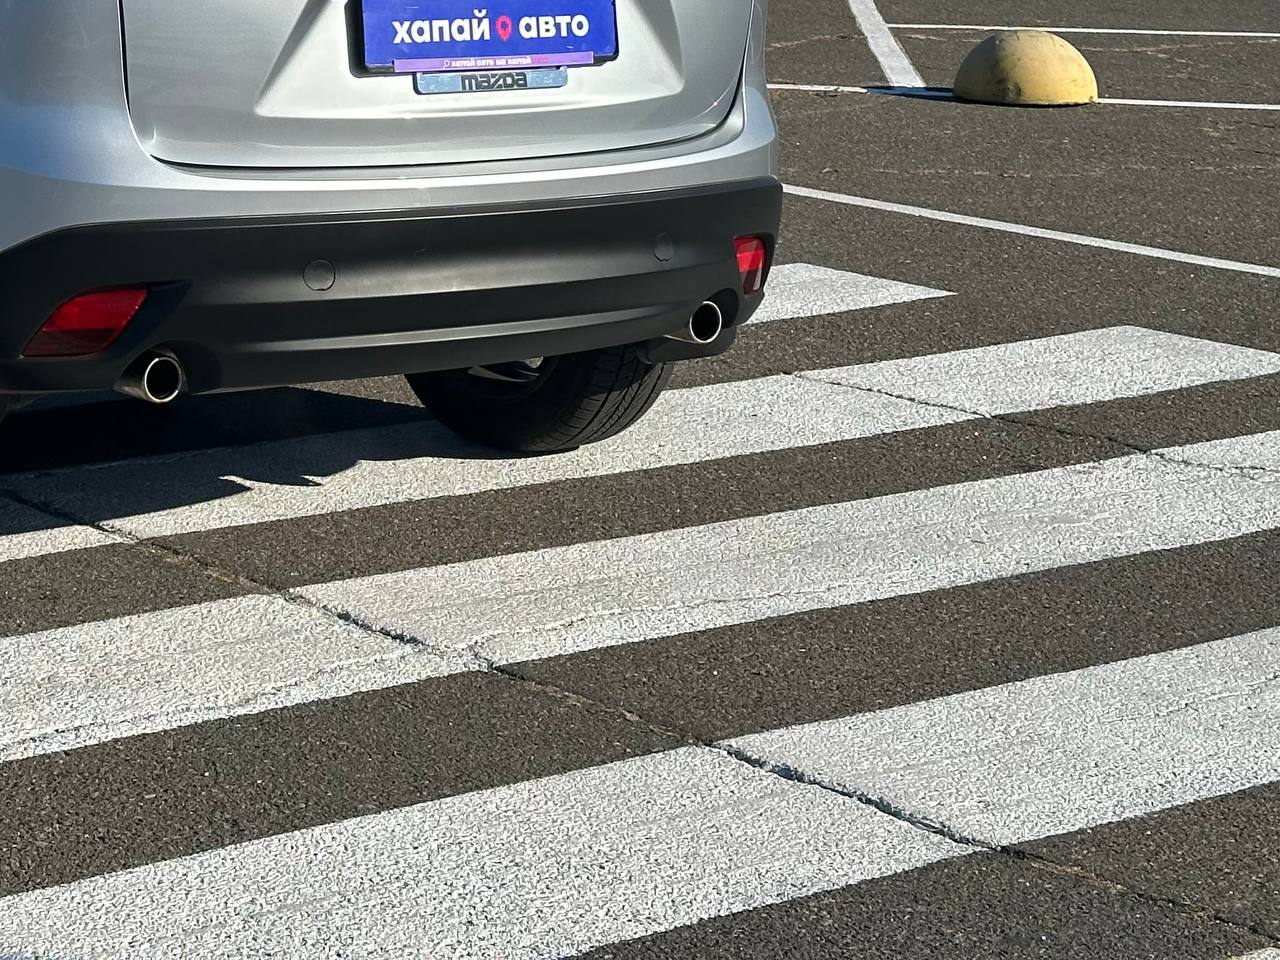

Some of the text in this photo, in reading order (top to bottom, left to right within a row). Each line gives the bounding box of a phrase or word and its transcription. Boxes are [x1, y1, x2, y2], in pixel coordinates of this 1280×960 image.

[392, 8, 589, 44] хапай авто
[461, 72, 528, 91] mazda
